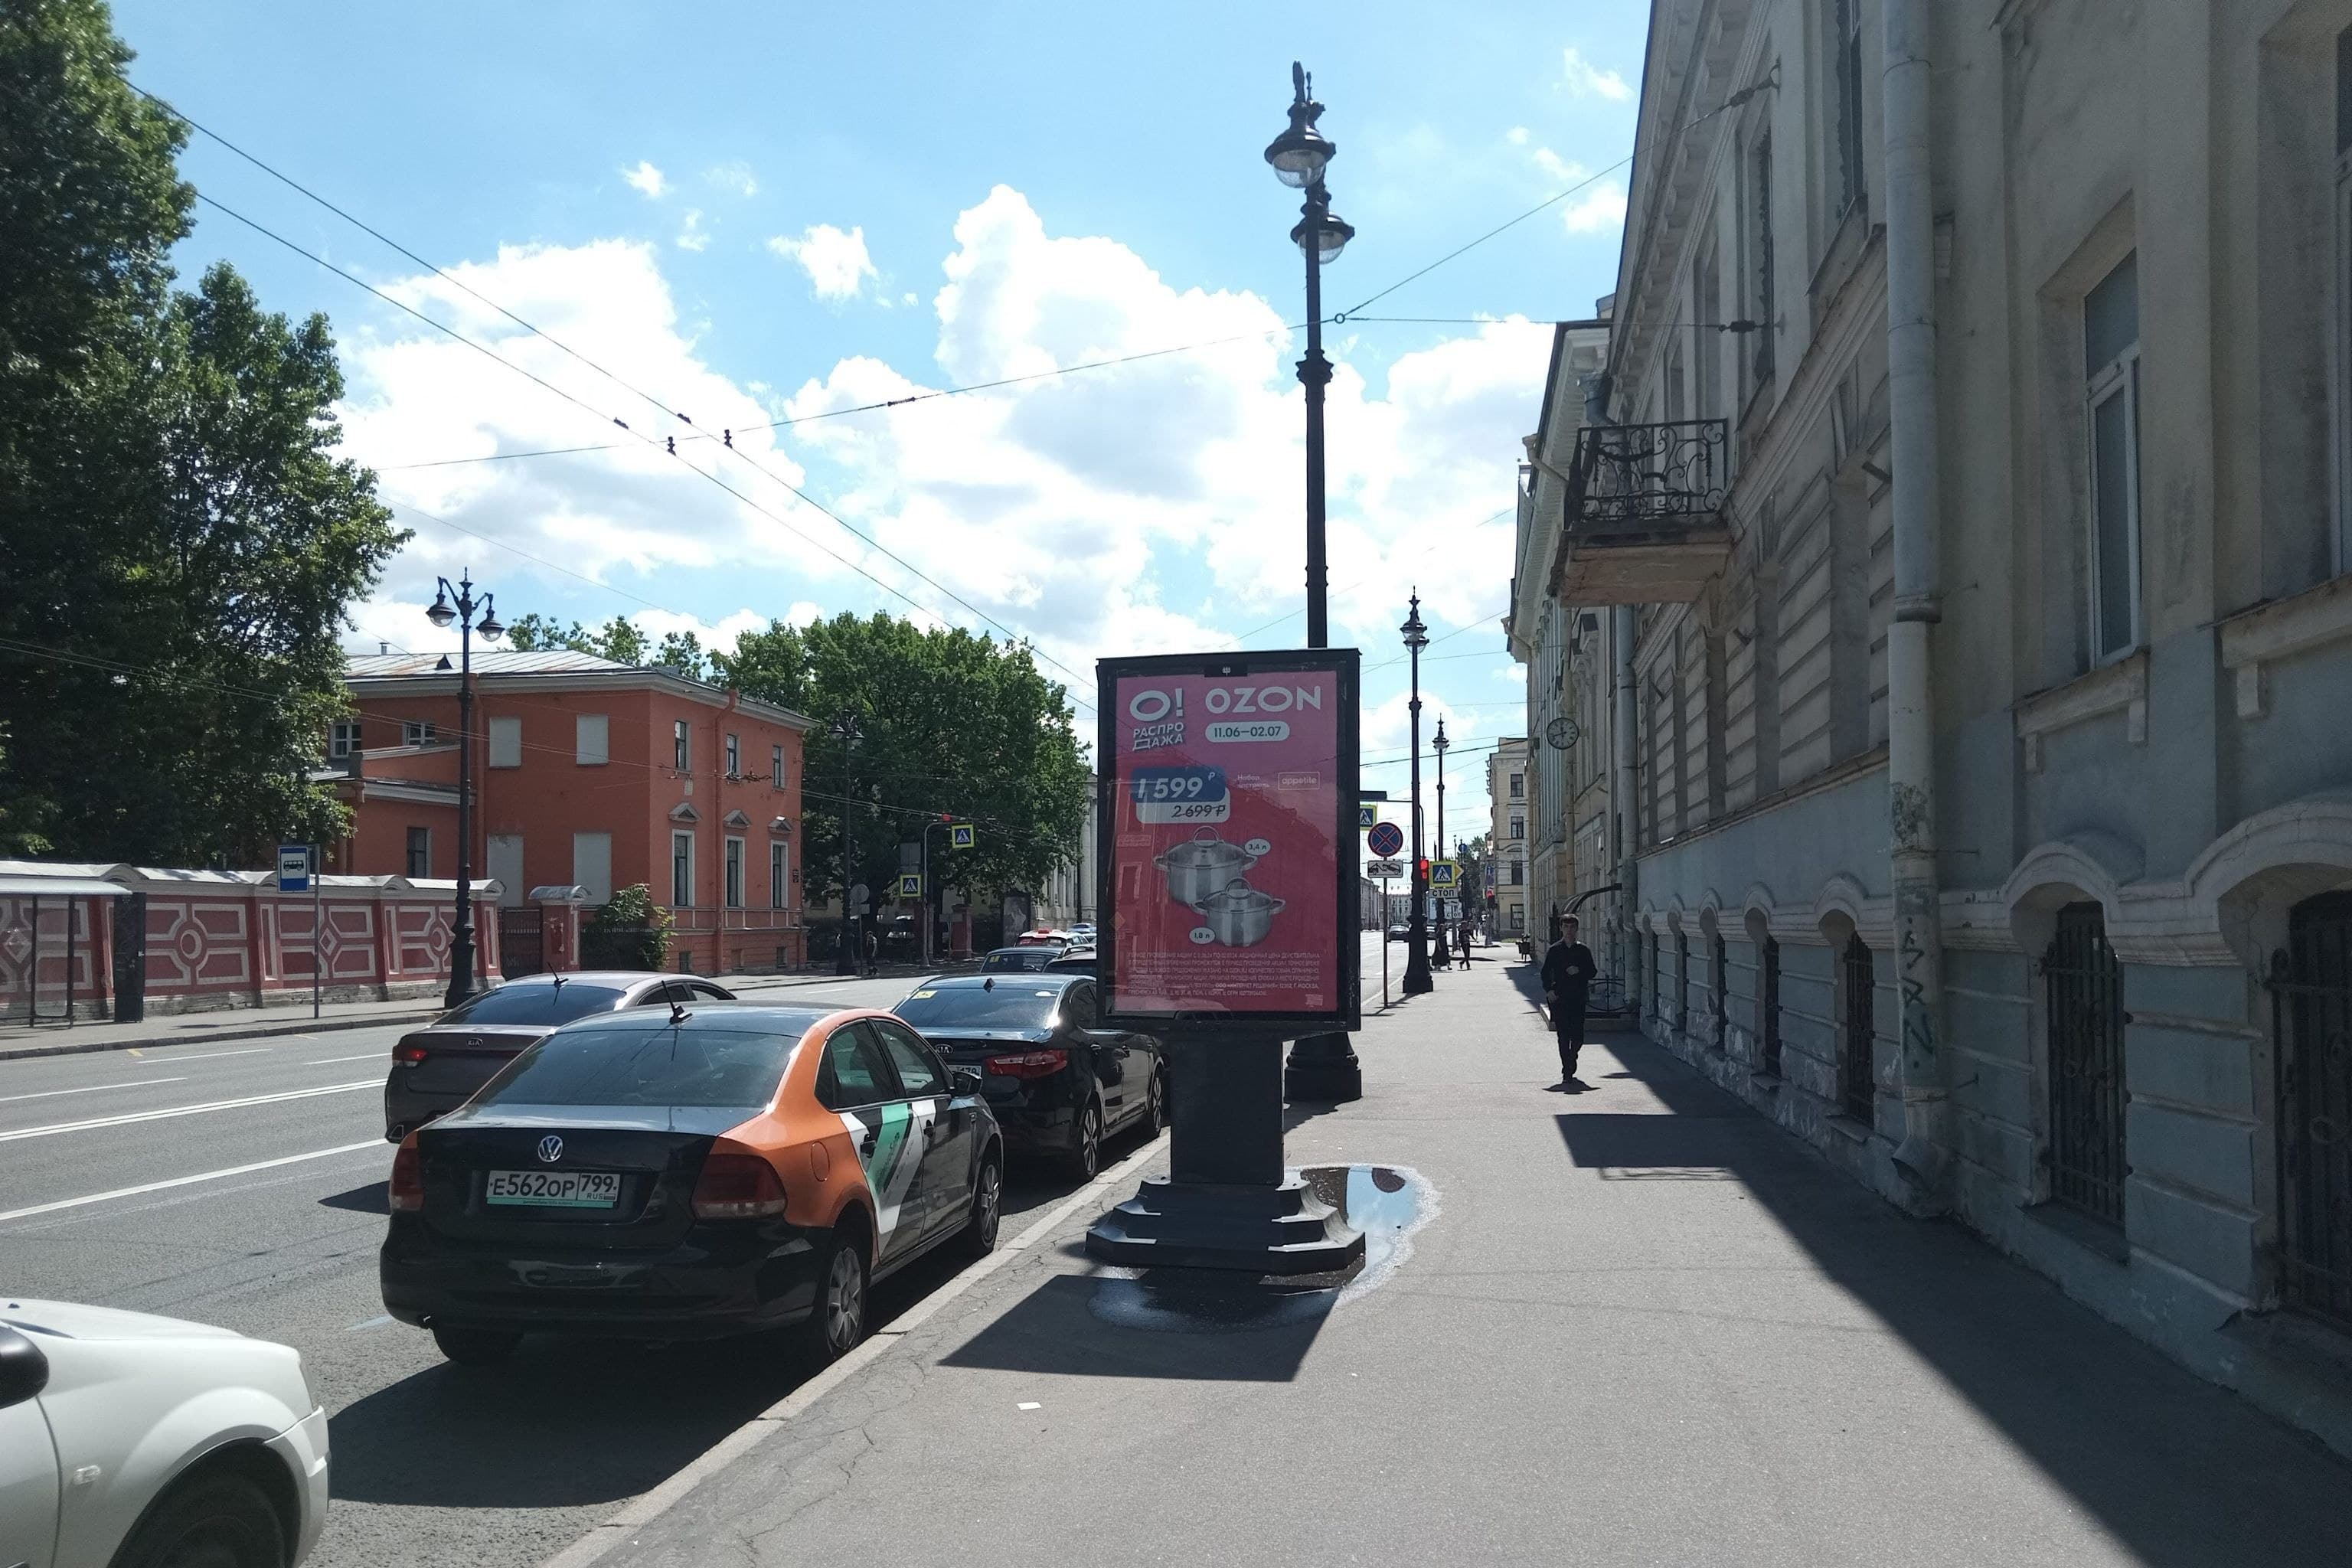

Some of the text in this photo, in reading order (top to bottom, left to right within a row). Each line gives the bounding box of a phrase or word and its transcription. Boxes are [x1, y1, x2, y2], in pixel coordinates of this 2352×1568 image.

[1204, 685, 1321, 714] OZON
[1132, 722, 1184, 739] РАСПРО
[1132, 733, 1184, 751] ДАЖА
[580, 1174, 615, 1193] 799
